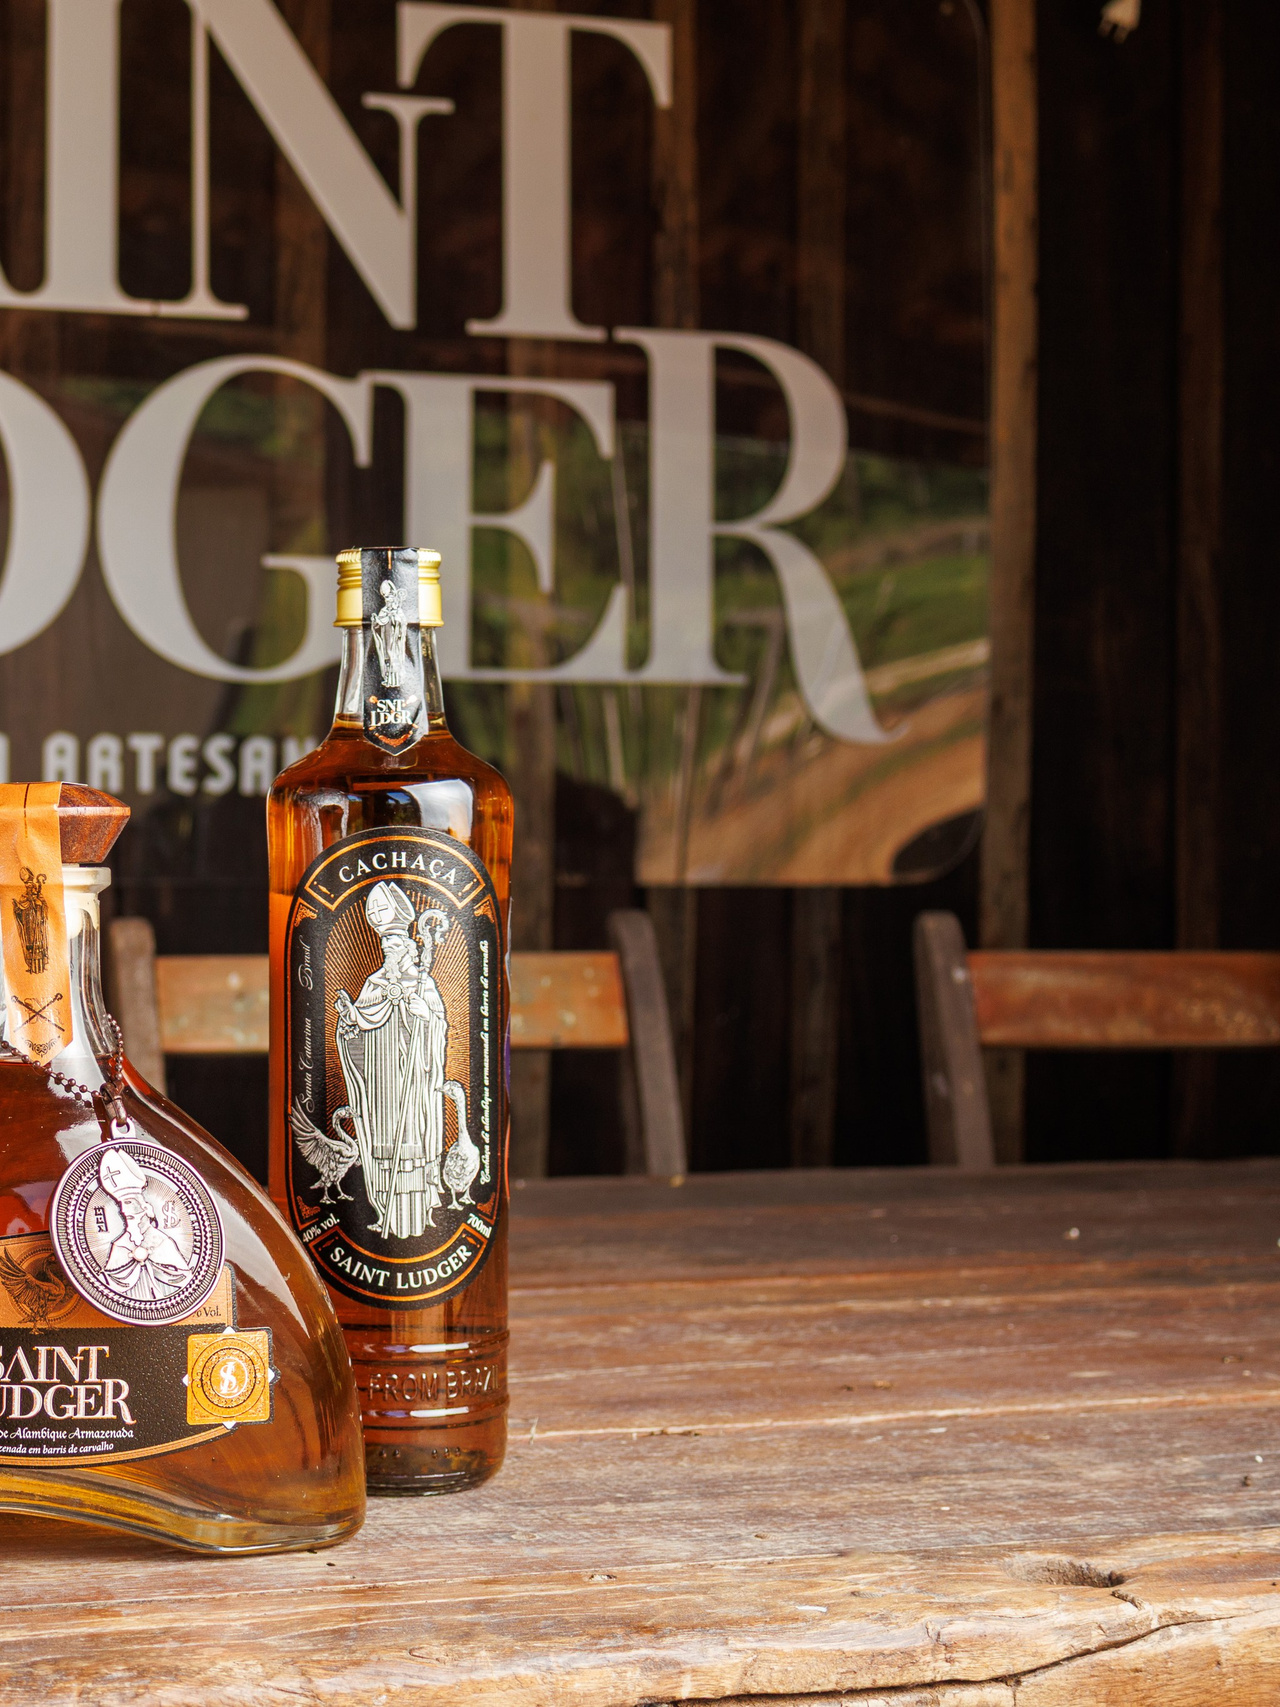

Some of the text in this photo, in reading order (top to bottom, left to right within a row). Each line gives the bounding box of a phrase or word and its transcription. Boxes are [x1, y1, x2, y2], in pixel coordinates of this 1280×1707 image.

[371, 710, 413, 727] LDGR
[376, 699, 405, 713] SNT
[338, 851, 457, 886] CACHAÇA
[298, 935, 315, 1113] Santa Catarina Brasil
[302, 1213, 340, 1243] 40% vol.
[466, 1213, 492, 1239] 700ml
[330, 1244, 472, 1290] SAINT LUDGER
[202, 1306, 222, 1318] Vol.
[370, 1373, 439, 1401] FROM
[9, 1427, 67, 1441] Alambique
[67, 1427, 134, 1439] Armazenada
[28, 1446, 41, 1455] em
[42, 1444, 67, 1455] barris
[68, 1443, 78, 1454] de
[79, 1441, 114, 1453] carvalho
